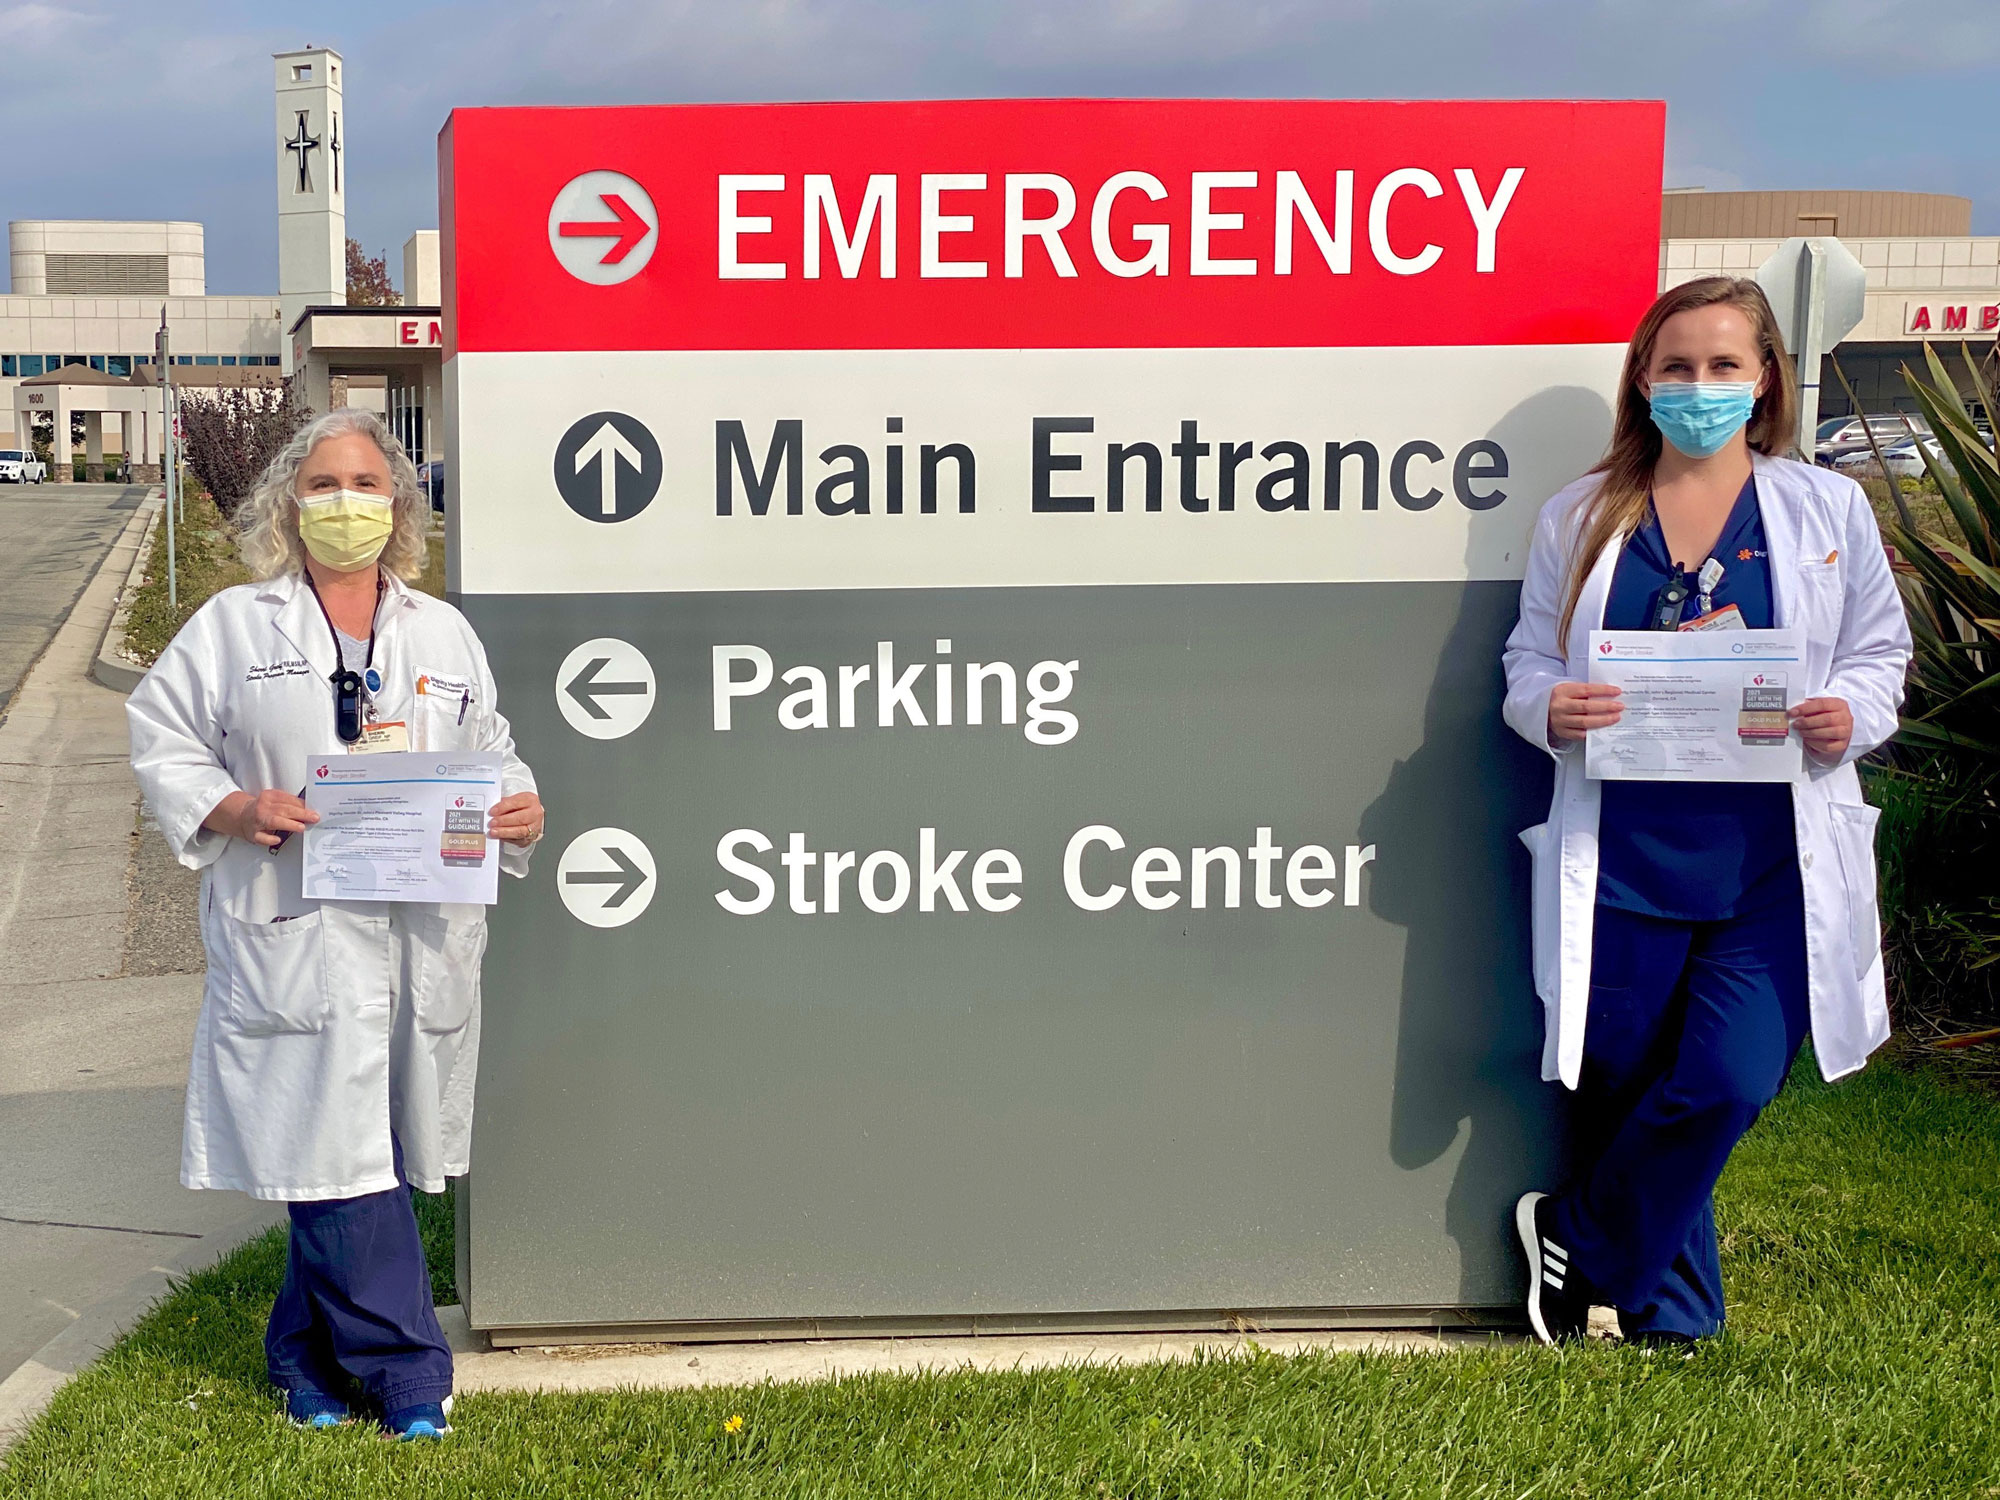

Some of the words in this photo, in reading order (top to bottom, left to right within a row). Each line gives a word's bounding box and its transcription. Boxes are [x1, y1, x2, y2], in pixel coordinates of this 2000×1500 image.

[718, 167, 1526, 281] EMERGENCY
[28, 393, 44, 404] 1600
[715, 416, 976, 517] Main
[1031, 416, 1509, 513] Entrance
[712, 638, 1079, 746] Parking
[714, 826, 1023, 916] Stroke
[1063, 824, 1376, 911] Center
